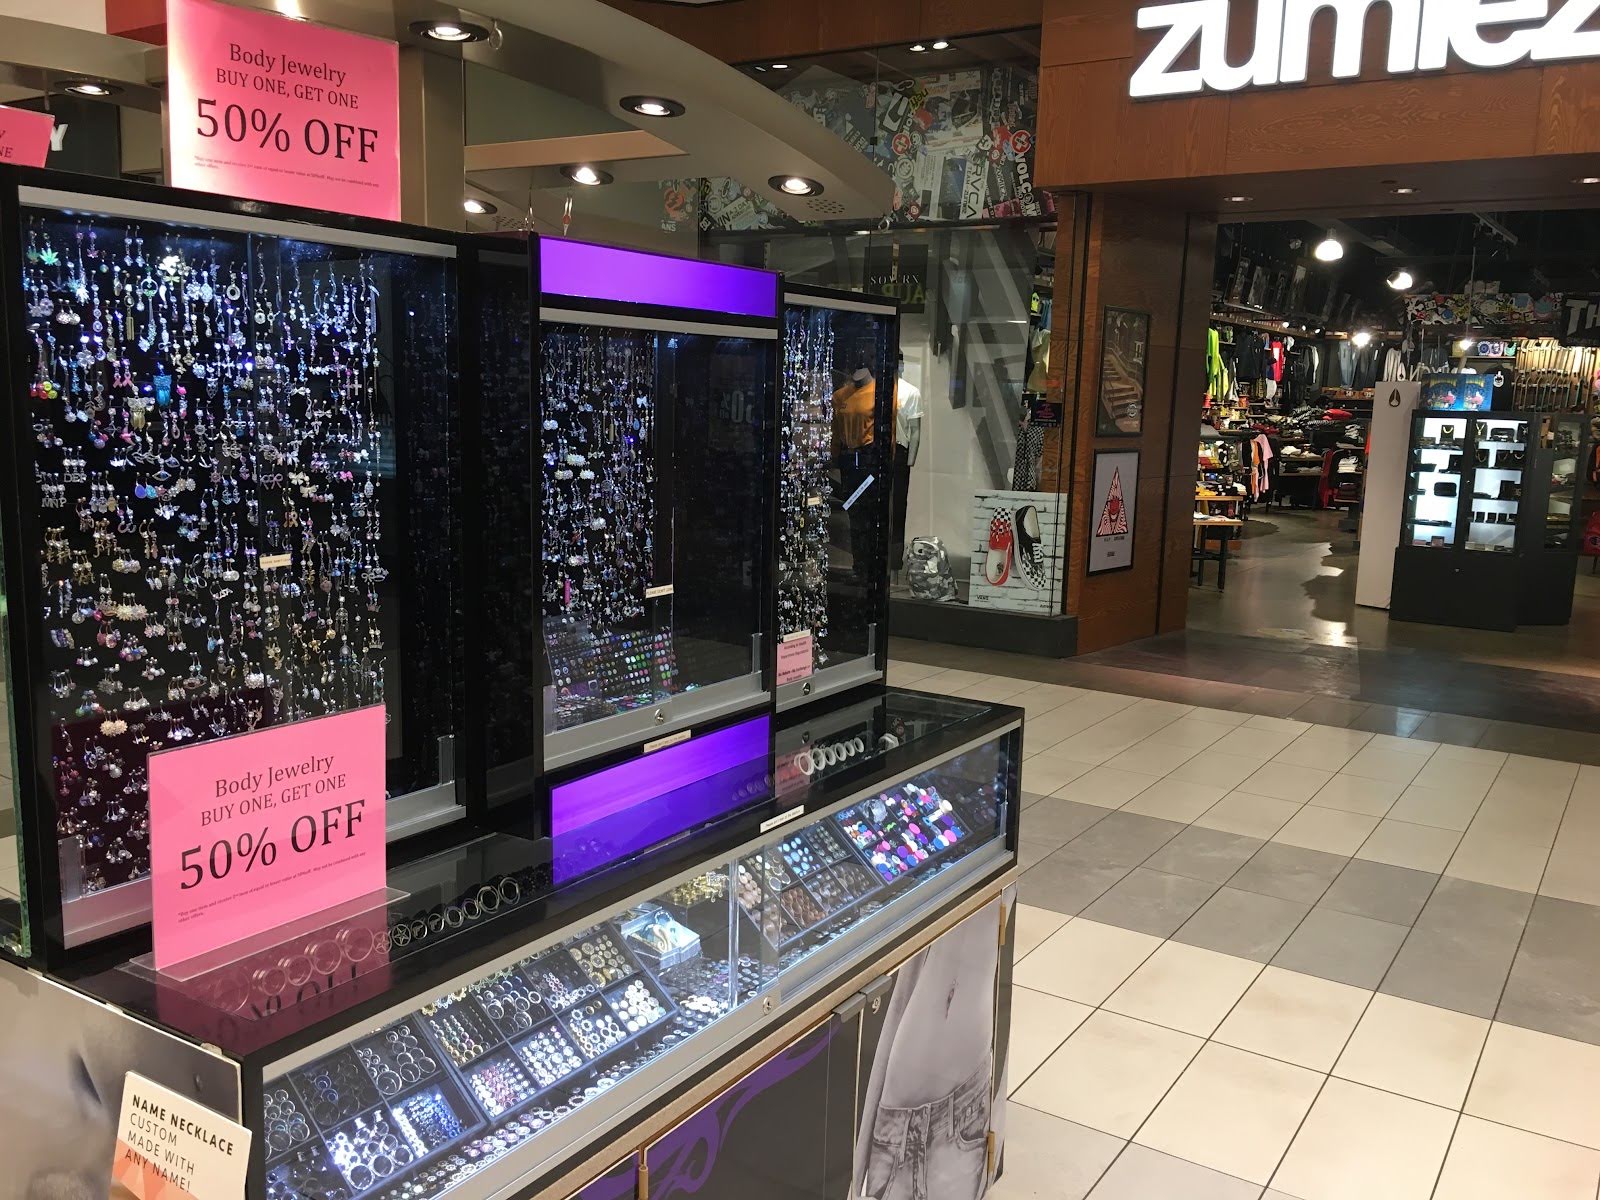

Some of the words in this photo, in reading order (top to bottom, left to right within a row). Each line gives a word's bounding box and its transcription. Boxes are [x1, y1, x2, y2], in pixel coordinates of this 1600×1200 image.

[229, 43, 276, 72] Body
[280, 55, 346, 87] Jewelry
[216, 68, 249, 88] BUY
[253, 75, 290, 98] ONE,
[294, 84, 324, 102] GET
[328, 91, 358, 109] ONE
[197, 98, 290, 152] 50%
[304, 118, 378, 163] OFF
[215, 773, 262, 797] Body
[268, 756, 334, 787] Jewelry
[201, 804, 235, 827] BUY
[239, 793, 277, 816] ONE,
[281, 784, 311, 804] GET
[315, 773, 346, 794] ONE
[180, 827, 277, 889] 50%
[291, 799, 366, 853] OFF
[130, 1113, 177, 1146] CUSTOM
[132, 1094, 166, 1120] NAME
[170, 1113, 233, 1156] NECKLACE
[125, 1149, 148, 1169] ANY
[153, 1162, 191, 1193] NAME!
[128, 1130, 160, 1157] MADE
[165, 1149, 195, 1175] WITH
